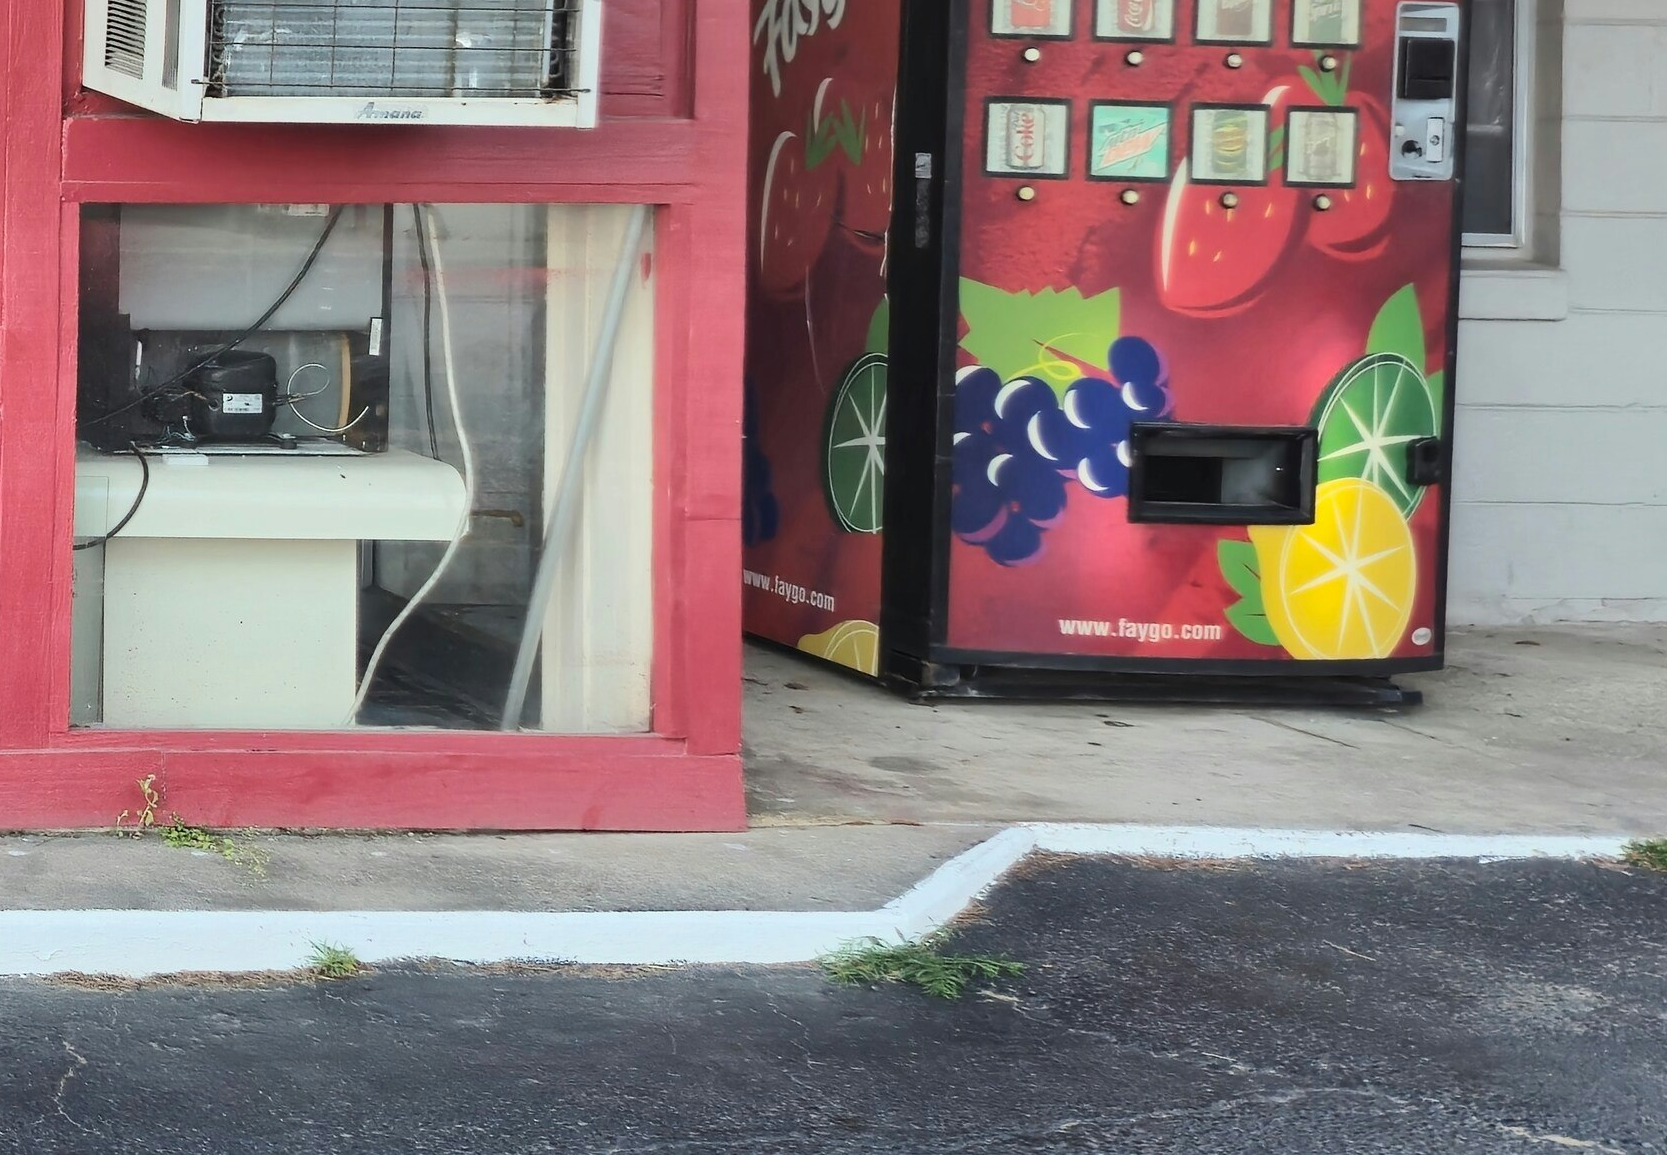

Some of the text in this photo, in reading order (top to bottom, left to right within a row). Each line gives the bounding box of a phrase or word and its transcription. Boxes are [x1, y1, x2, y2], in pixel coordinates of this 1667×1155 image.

[357, 102, 422, 119] Amana
[743, 568, 835, 613] www.faygo.com
[1058, 618, 1221, 643] www.faygo.com
